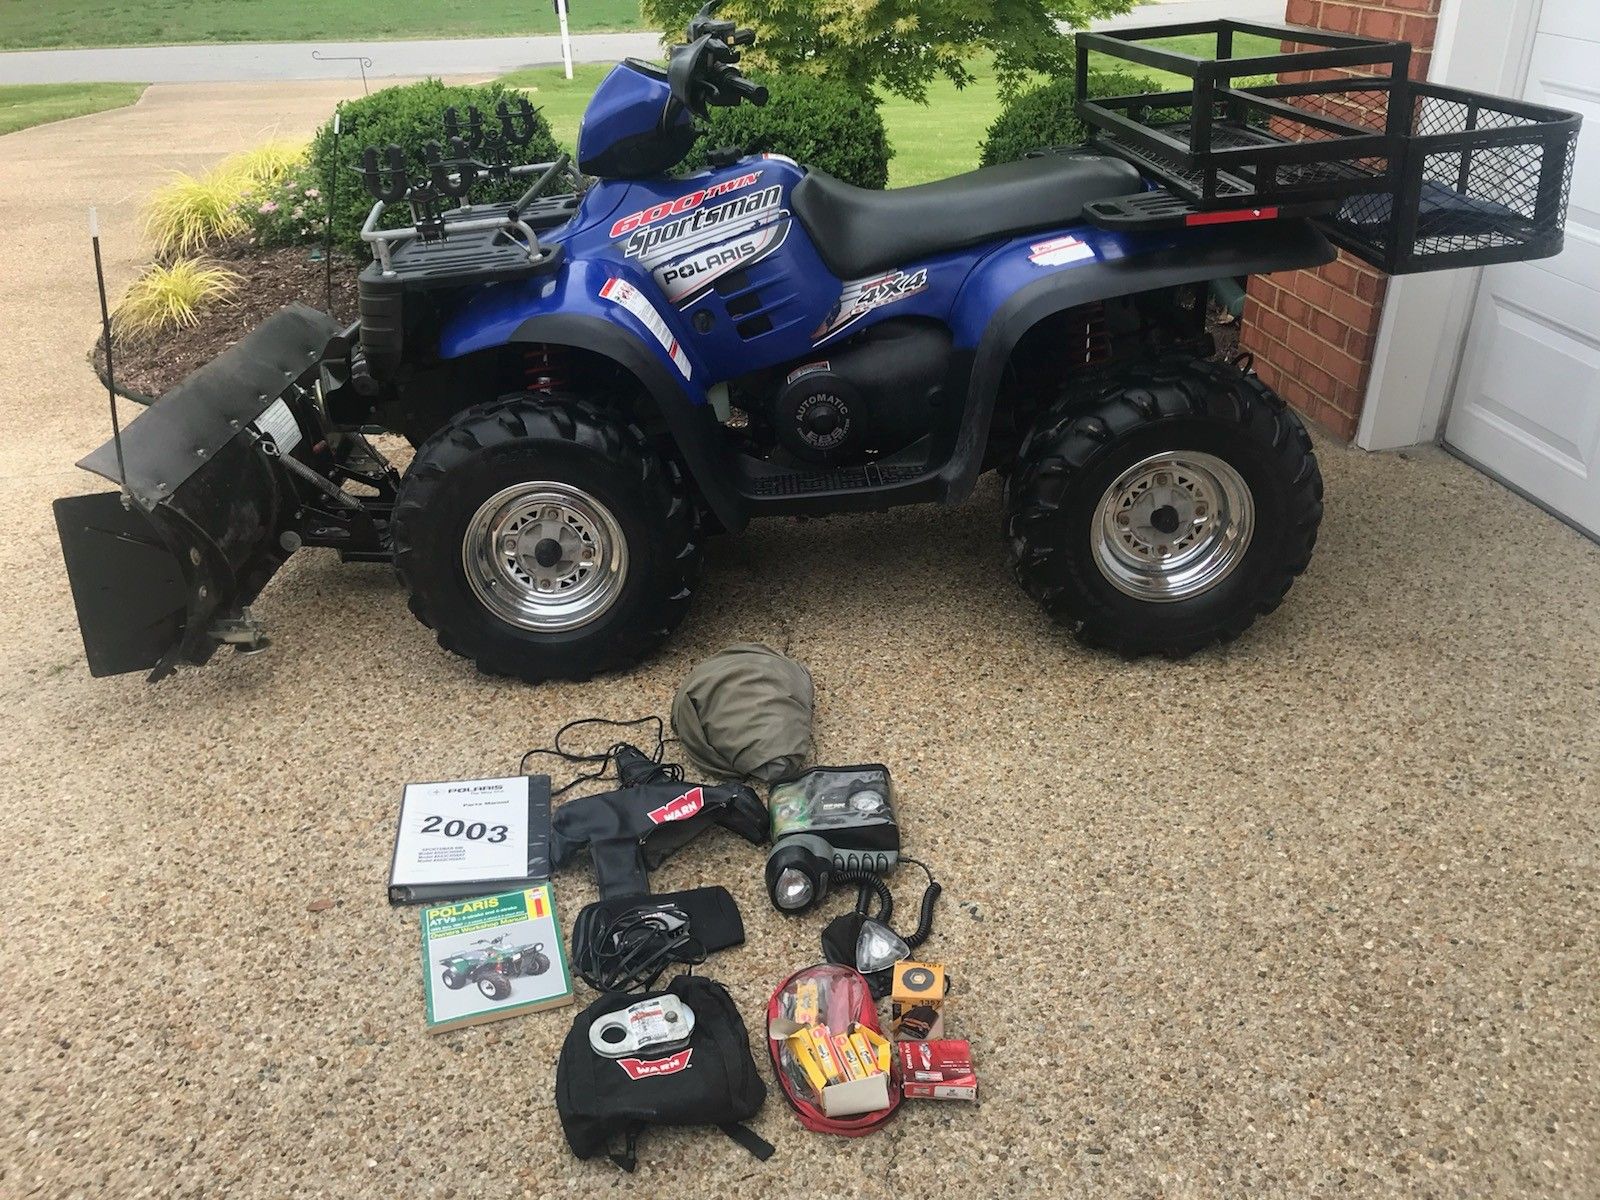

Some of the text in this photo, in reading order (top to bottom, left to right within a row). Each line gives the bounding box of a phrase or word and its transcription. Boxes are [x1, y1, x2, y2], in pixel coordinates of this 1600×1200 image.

[609, 172, 760, 238] 600 TWIN
[624, 185, 782, 259] Sportsman
[663, 241, 756, 285] POLARIS
[796, 393, 848, 422] AUTOMATIC
[448, 785, 503, 793] POLARIS
[664, 801, 698, 821] WARN
[420, 815, 509, 843] 2003
[429, 898, 499, 920] POLARIS
[636, 1059, 681, 1075] WARN
